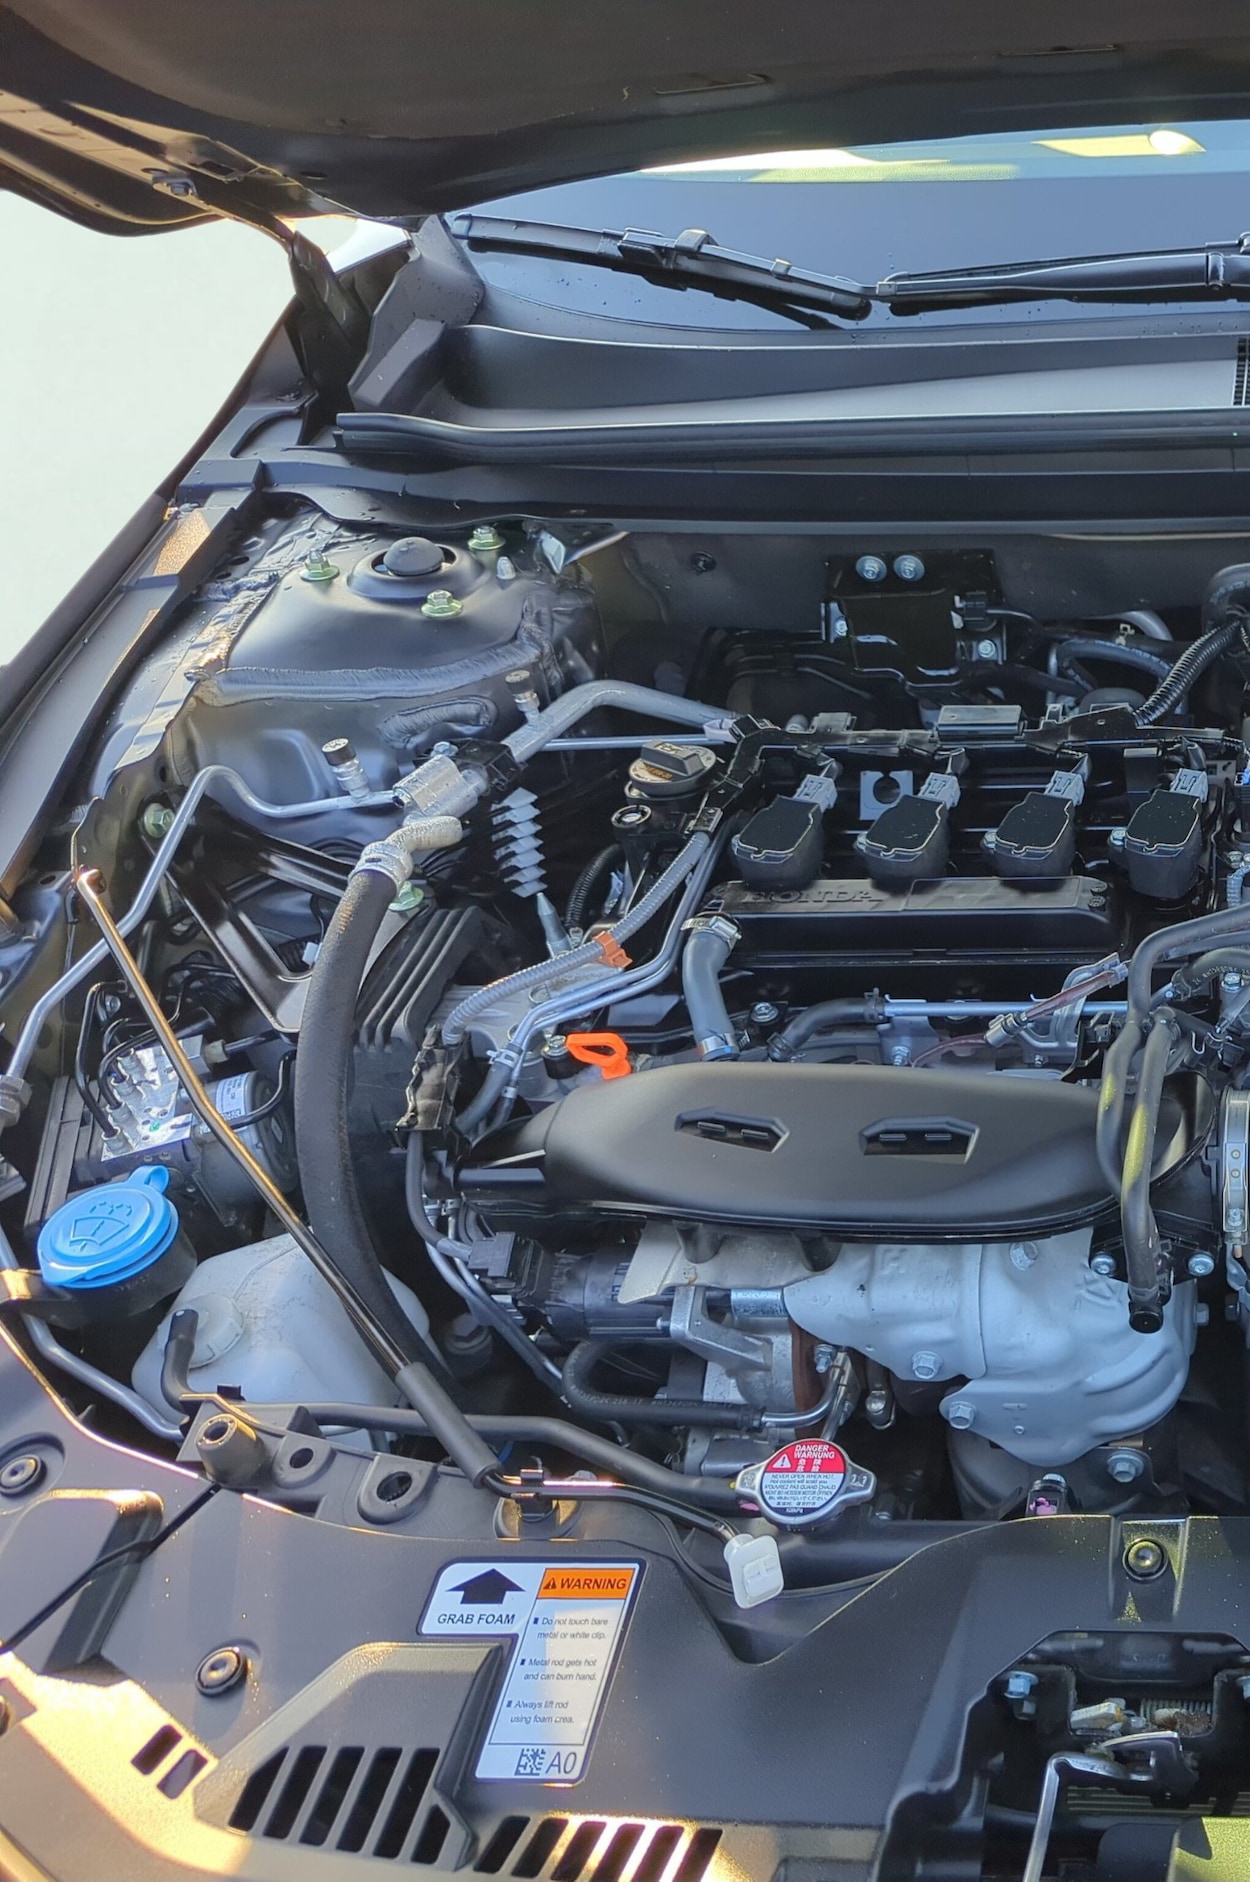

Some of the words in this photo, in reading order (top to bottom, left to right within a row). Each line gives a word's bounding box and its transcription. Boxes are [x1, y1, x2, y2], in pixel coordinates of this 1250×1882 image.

[741, 890, 883, 903] HONDA
[794, 1451, 835, 1459] WARNUNG
[560, 1578, 627, 1590] WARNING
[437, 1613, 474, 1625] GRAB
[477, 1613, 516, 1625] FOAM
[541, 1617, 553, 1625] Do
[554, 1617, 567, 1625] not
[568, 1617, 589, 1625] touch
[591, 1617, 609, 1625] bare
[537, 1631, 559, 1639] metal
[570, 1631, 590, 1639] white
[528, 1658, 550, 1666] Metal
[551, 1658, 565, 1666] rod
[565, 1659, 582, 1668] gets
[584, 1658, 597, 1666] hot
[523, 1672, 540, 1680] and
[575, 1672, 597, 1680] hand.
[514, 1700, 543, 1710] Always
[544, 1700, 554, 1708] lift
[555, 1700, 569, 1708] rod
[510, 1714, 532, 1725] using
[533, 1714, 553, 1723] foam
